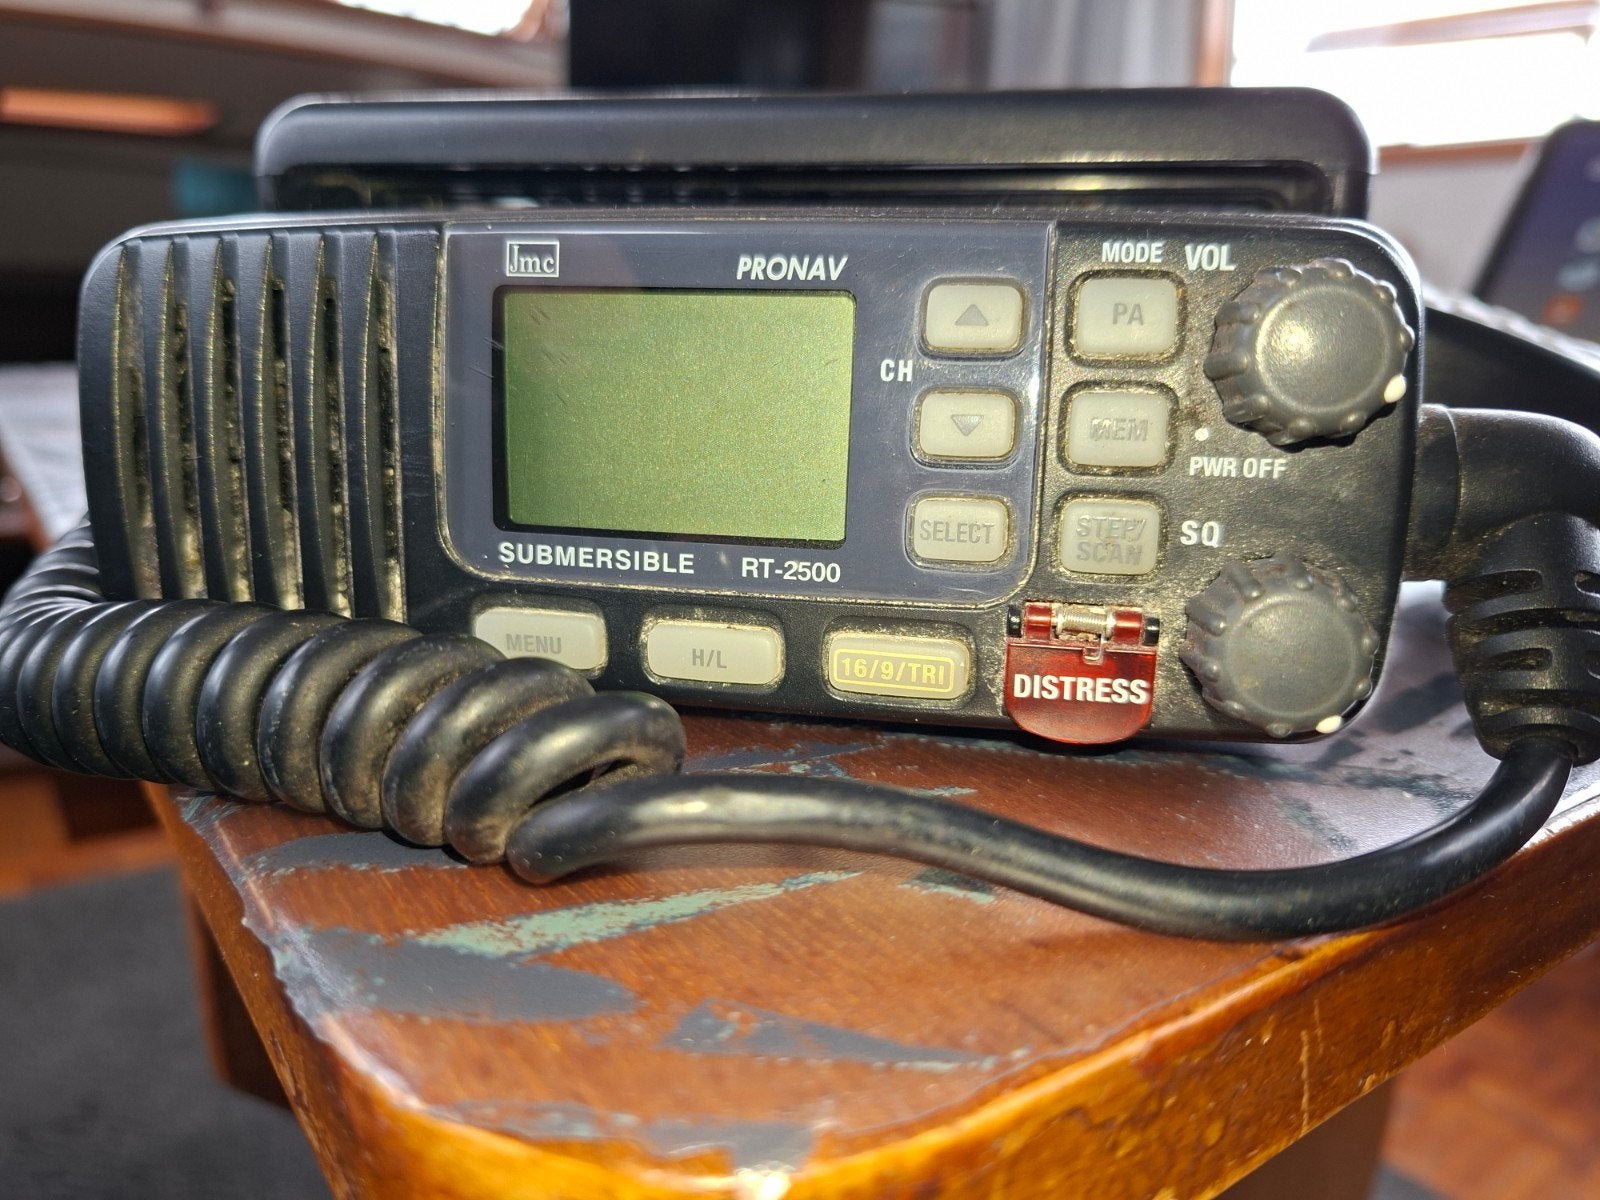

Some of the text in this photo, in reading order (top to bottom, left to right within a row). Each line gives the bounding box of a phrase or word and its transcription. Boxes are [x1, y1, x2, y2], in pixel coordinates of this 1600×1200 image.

[1101, 242, 1164, 264] MODE
[1184, 243, 1236, 272] VOL
[736, 255, 848, 281] PRONAV
[1112, 302, 1144, 326] PA
[880, 359, 913, 382] CH
[1089, 418, 1149, 442] MEM
[1189, 456, 1287, 479] PWR OFF
[919, 518, 995, 544] SELECT
[1180, 520, 1222, 547] SQ
[499, 541, 695, 575] SUBMERSIBLE
[1075, 541, 1142, 565] SCAN
[741, 556, 842, 583] RT-2500
[505, 633, 563, 656] MENU
[691, 648, 728, 669] H/L
[841, 656, 946, 686] 16/9/TRI
[1013, 673, 1150, 704] DISTRESS
